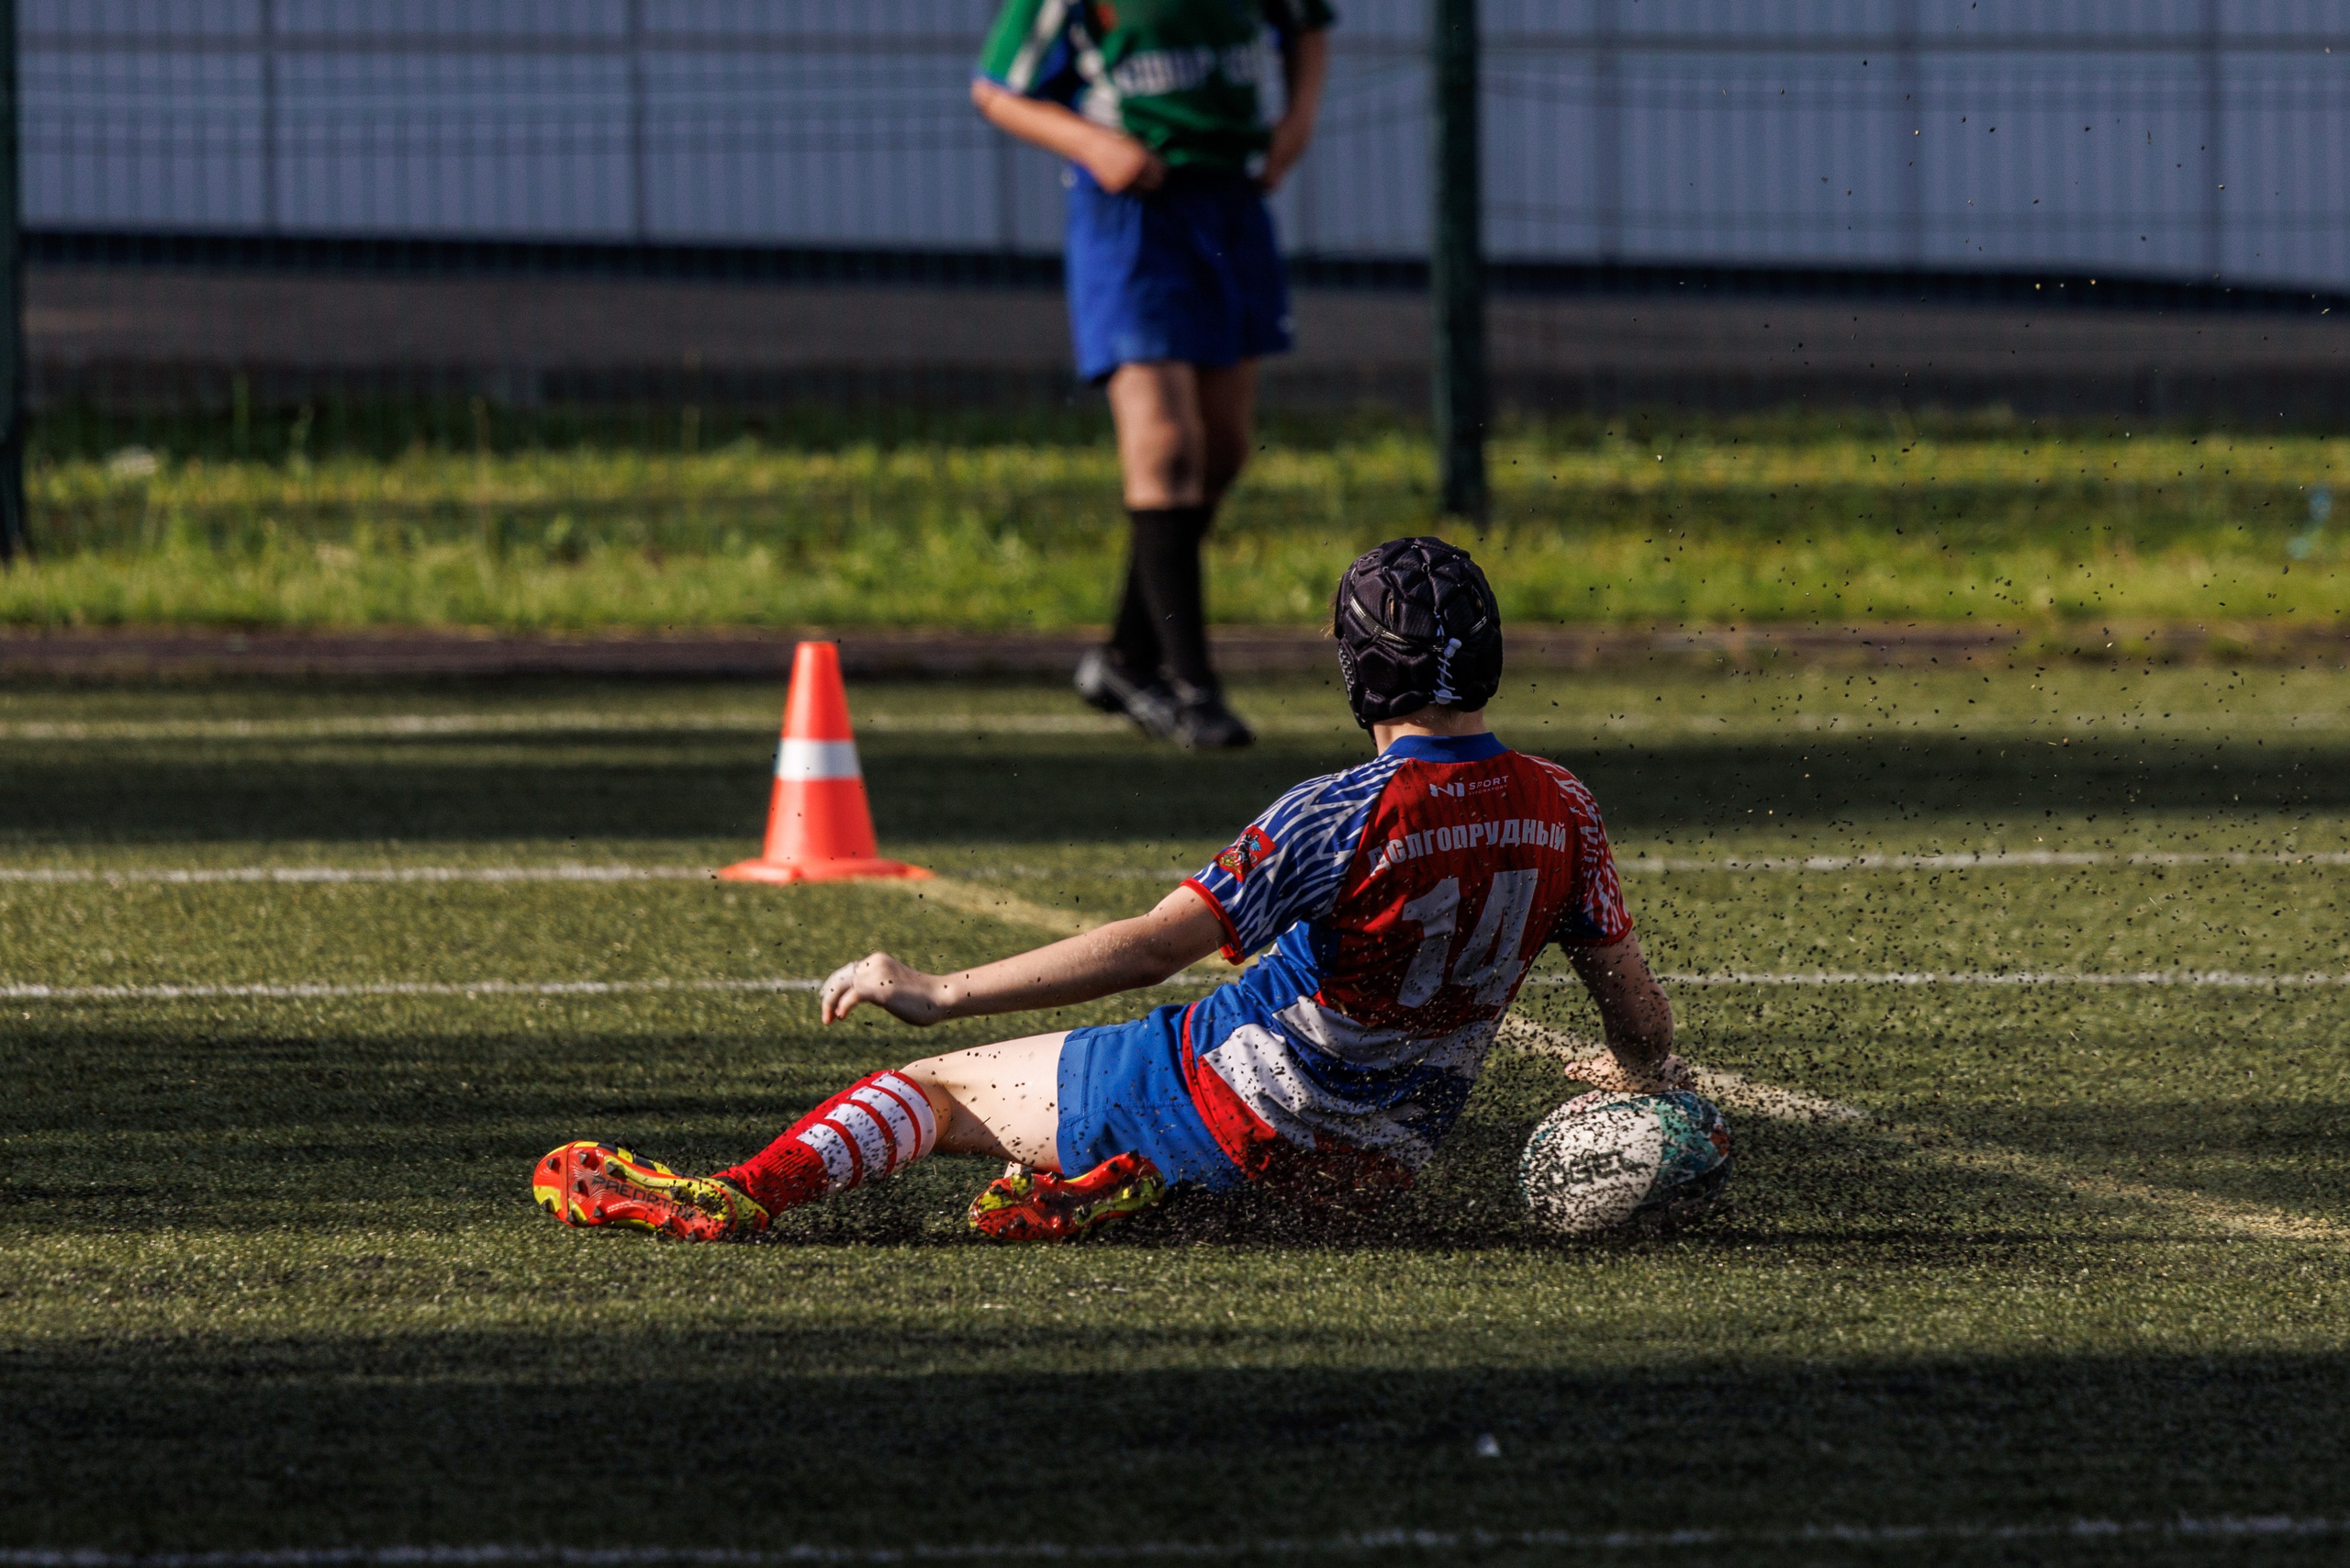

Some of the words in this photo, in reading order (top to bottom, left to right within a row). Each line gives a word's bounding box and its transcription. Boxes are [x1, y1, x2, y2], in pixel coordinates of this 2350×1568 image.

[1469, 775, 1509, 790] SPORT
[1367, 819, 1566, 877] ДОЛГОПРУДНЫЙ
[1396, 868, 1539, 1009] 14
